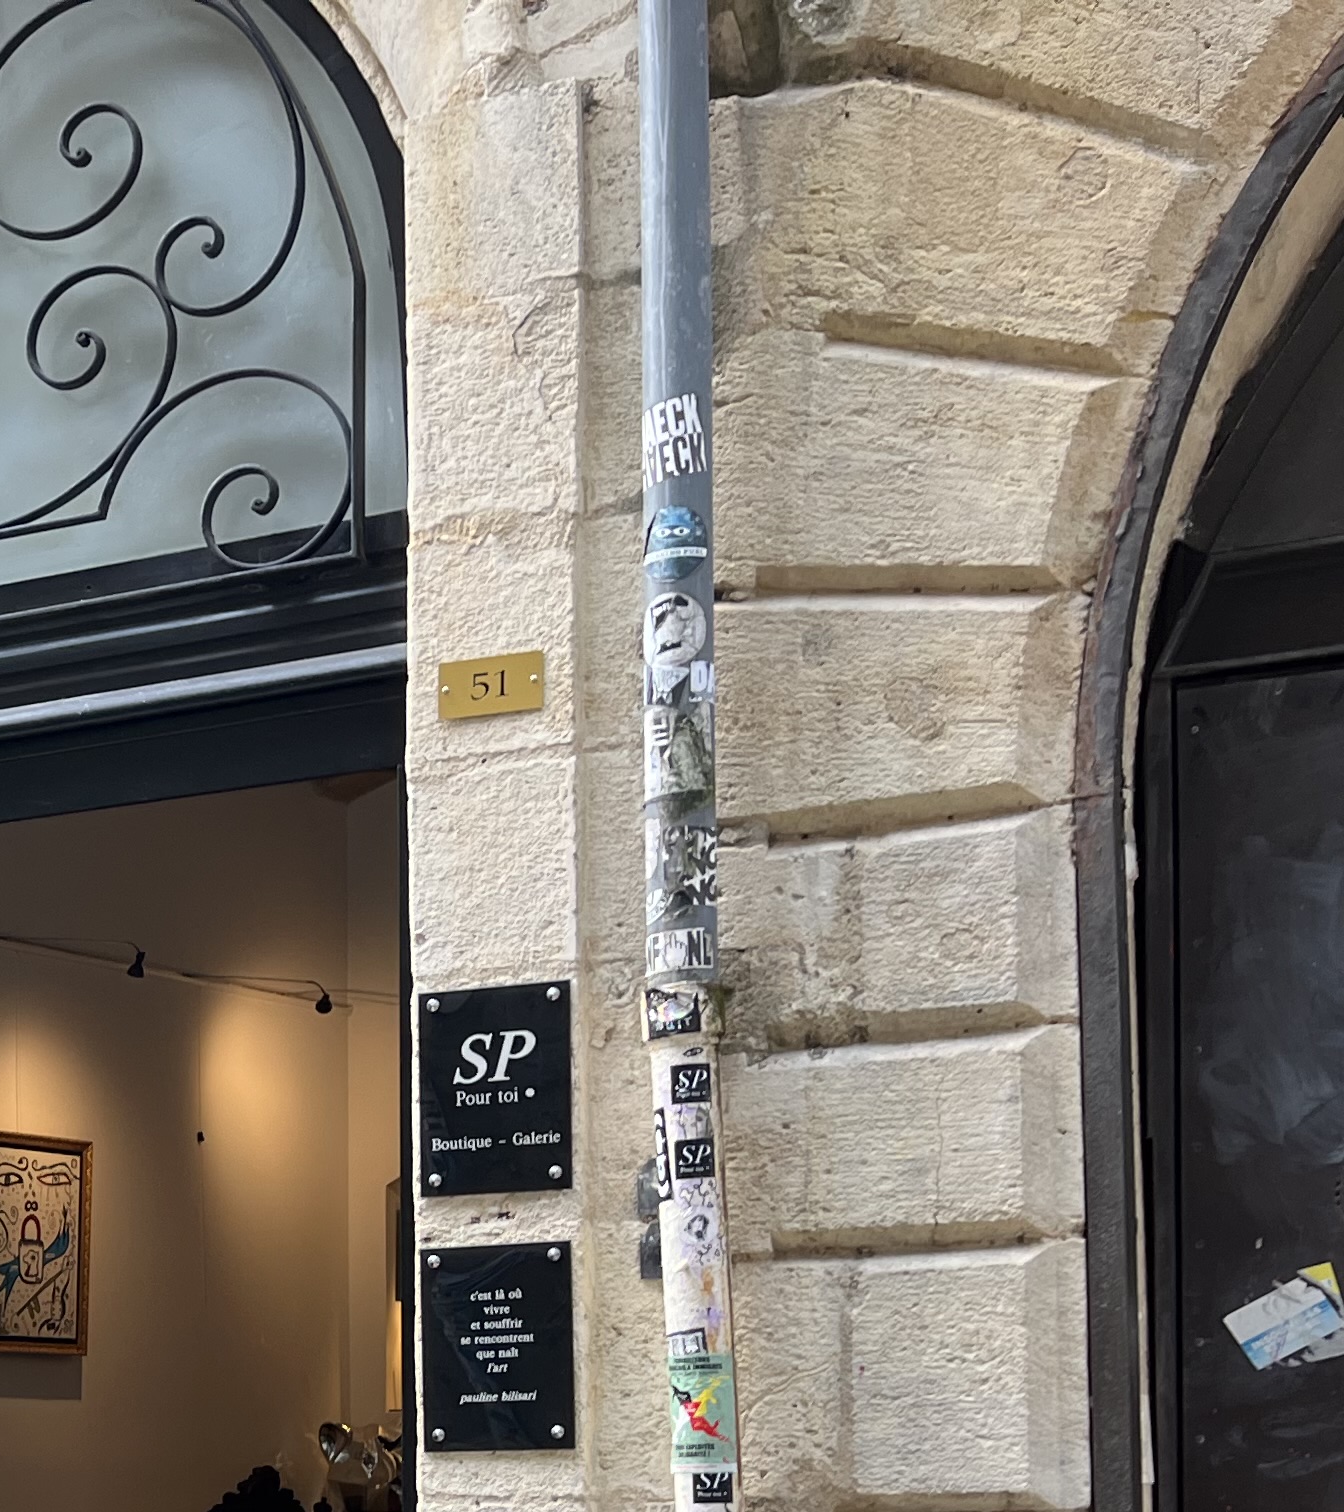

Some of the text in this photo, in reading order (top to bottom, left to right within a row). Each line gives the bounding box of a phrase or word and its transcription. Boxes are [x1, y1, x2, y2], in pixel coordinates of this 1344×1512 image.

[470, 669, 509, 701] 51
[453, 1029, 537, 1085] SP
[455, 1086, 519, 1107] Pour toi
[431, 1136, 492, 1152] Boutique
[512, 1129, 561, 1146] Galerie
[679, 1144, 711, 1166] SP
[470, 1287, 523, 1301] c'est là où
[483, 1304, 510, 1315] vivre
[470, 1318, 523, 1330] et souffrir
[460, 1333, 534, 1345] se rencontrent
[475, 1349, 496, 1361] que
[486, 1363, 508, 1374] l'art
[459, 1391, 498, 1405] pauline
